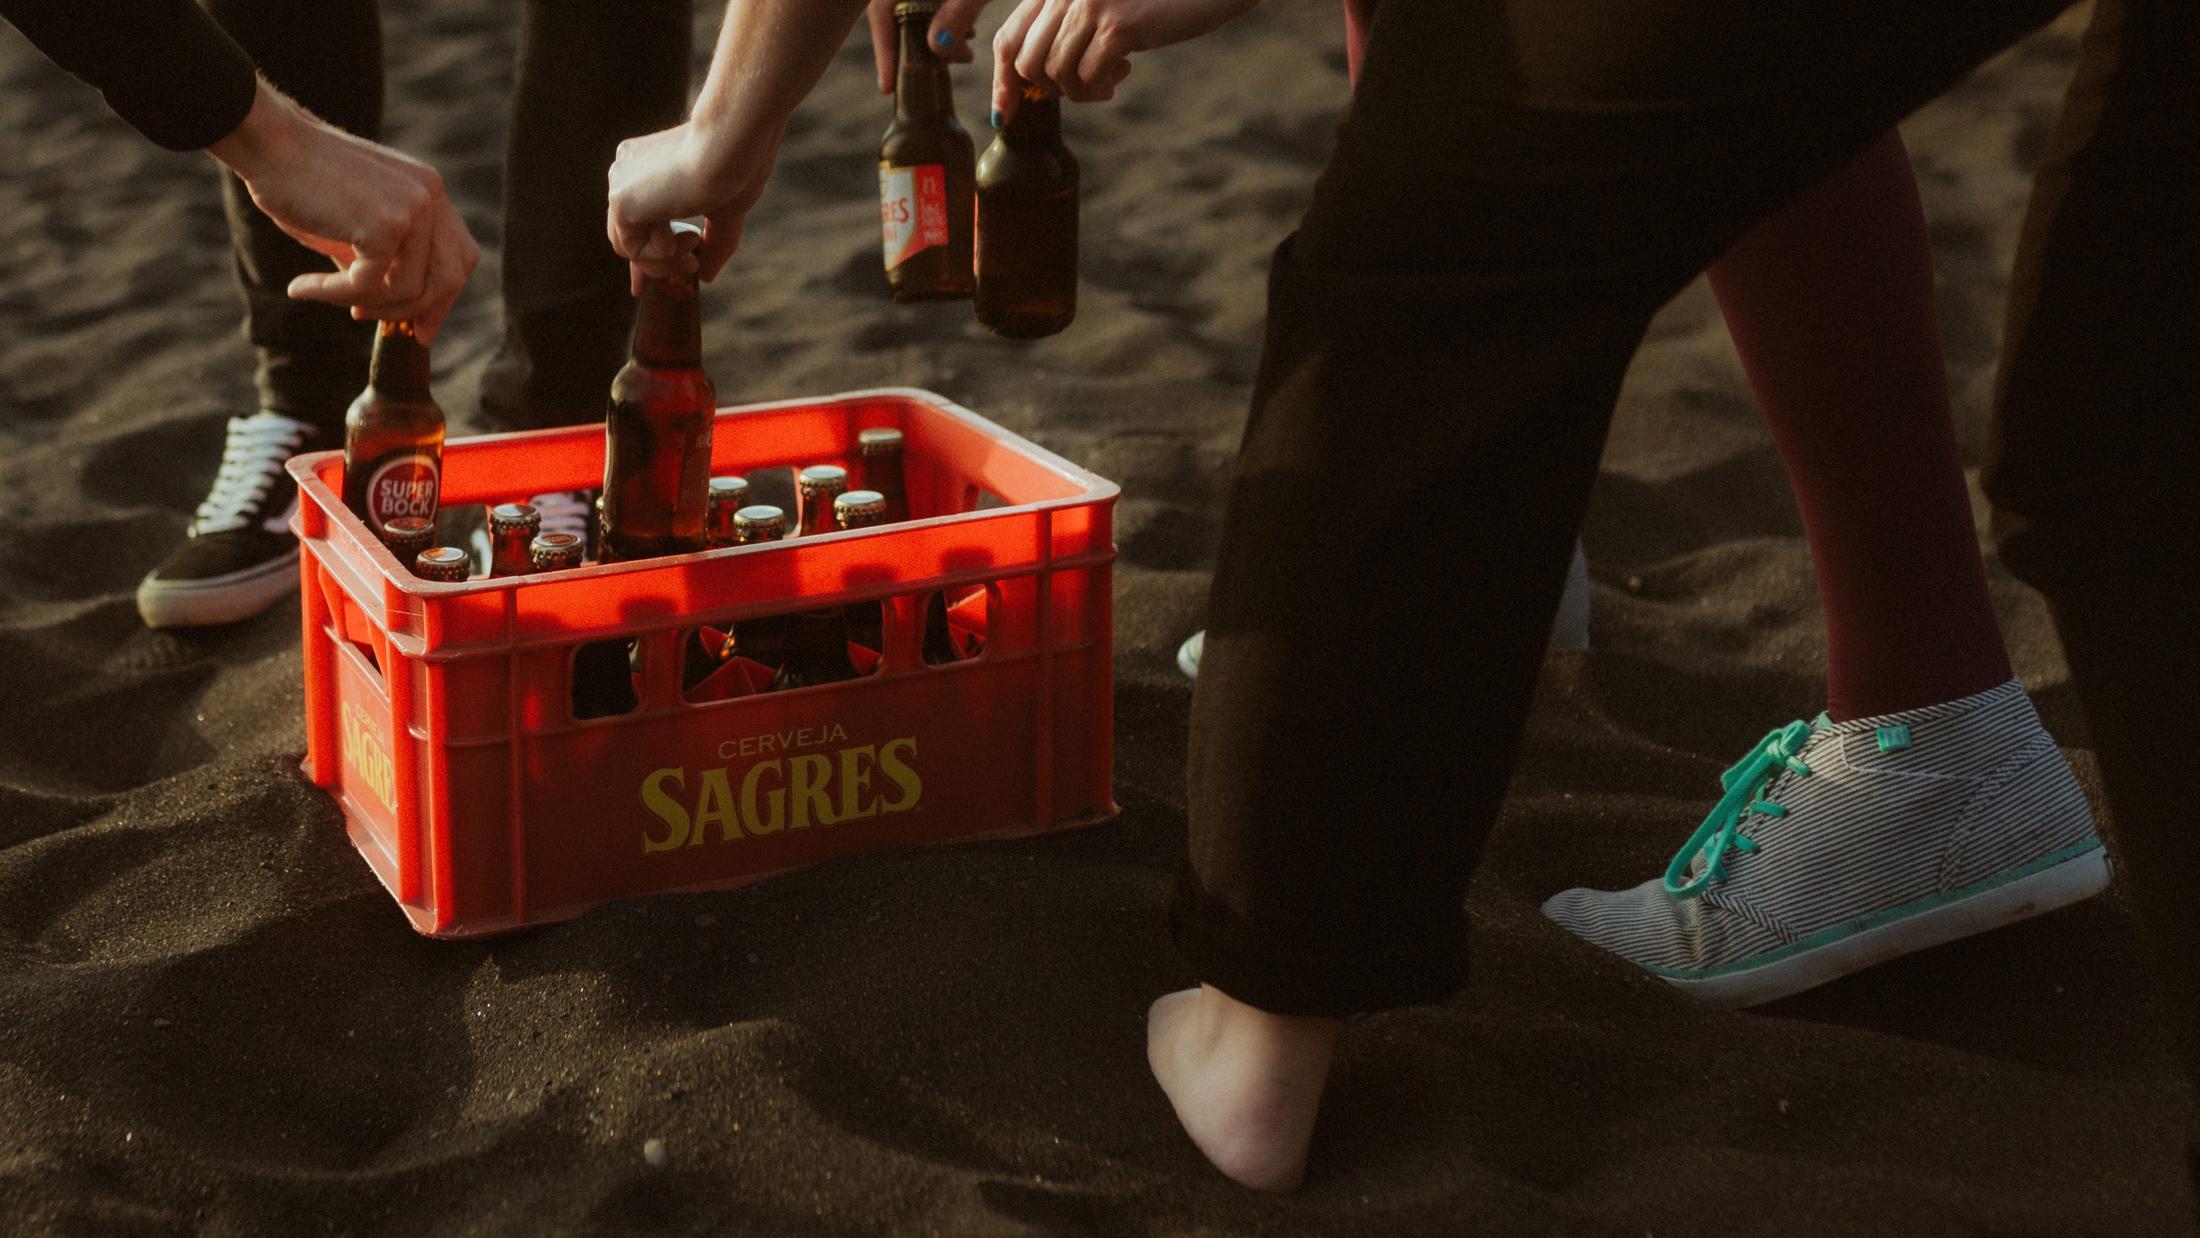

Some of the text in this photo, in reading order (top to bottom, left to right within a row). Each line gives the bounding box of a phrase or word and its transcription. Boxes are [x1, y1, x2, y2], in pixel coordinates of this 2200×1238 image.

[381, 479, 434, 499] SUPER
[381, 498, 430, 516] BOCK
[341, 700, 397, 815] SAGRE
[718, 723, 848, 760] CERVEJA
[641, 736, 923, 854] SAGRES
